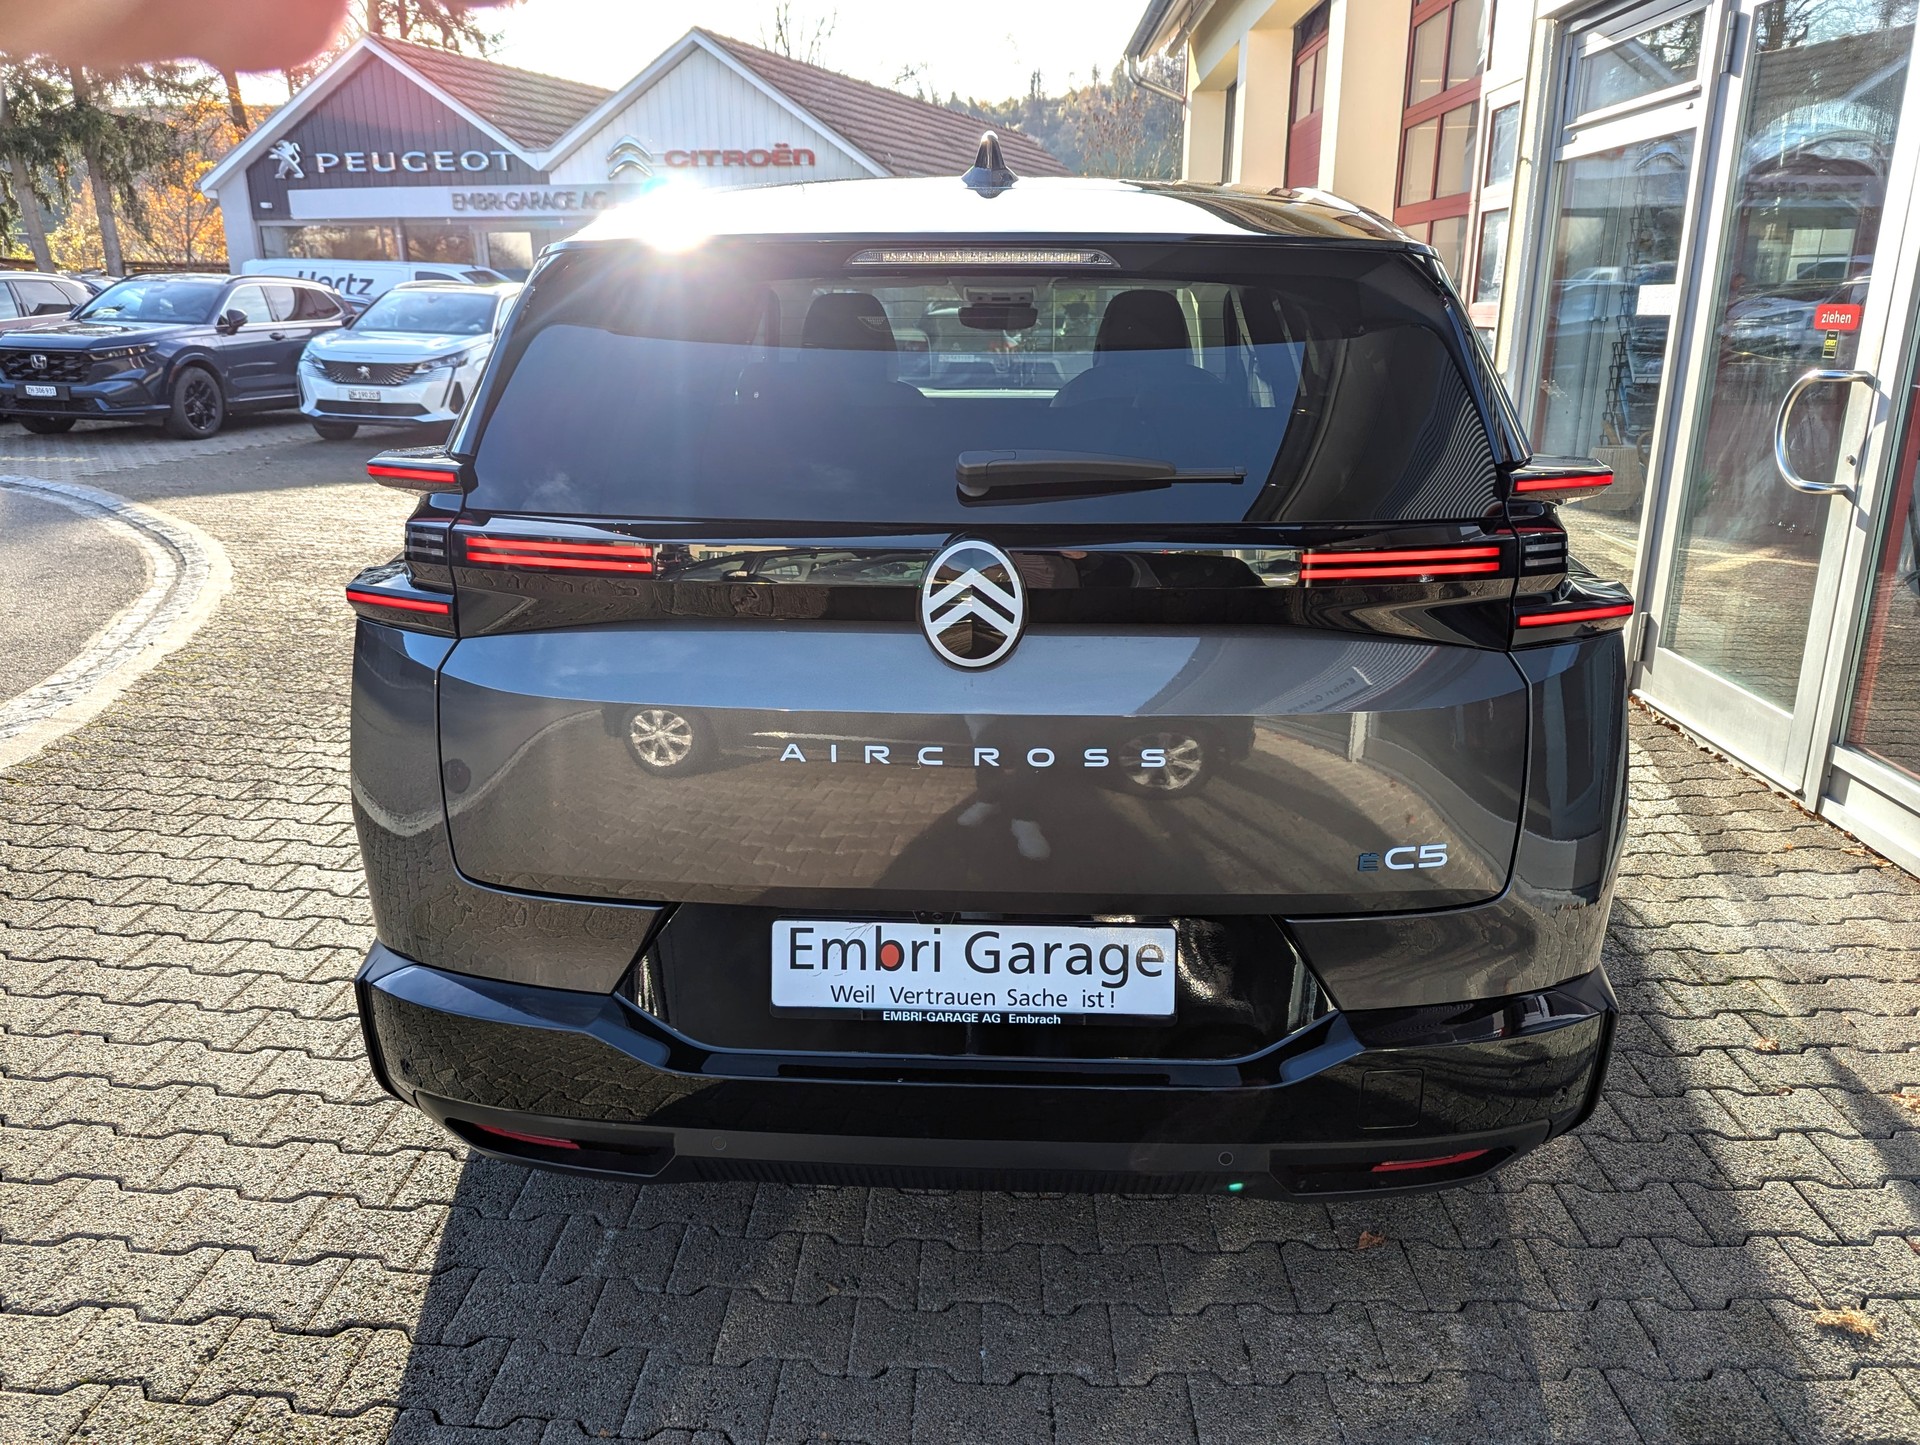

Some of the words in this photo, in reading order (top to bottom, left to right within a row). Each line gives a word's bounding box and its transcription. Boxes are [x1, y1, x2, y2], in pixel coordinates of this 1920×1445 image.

[315, 150, 514, 174] PEUGEOT
[452, 191, 578, 211] EMBRI-GARAGE
[581, 191, 607, 210] AG
[1821, 311, 1852, 324] ziehen
[780, 743, 1167, 769] AIRCROSS
[788, 925, 942, 972] Embri
[964, 930, 1165, 989] Garage
[830, 984, 874, 1004] Weil
[889, 985, 996, 1007] Vertrauen
[1007, 988, 1068, 1008] Sache
[882, 1011, 978, 1024] EMBRI-GARAGE
[982, 1013, 1001, 1024] AG
[1008, 1013, 1061, 1025] Embrach
